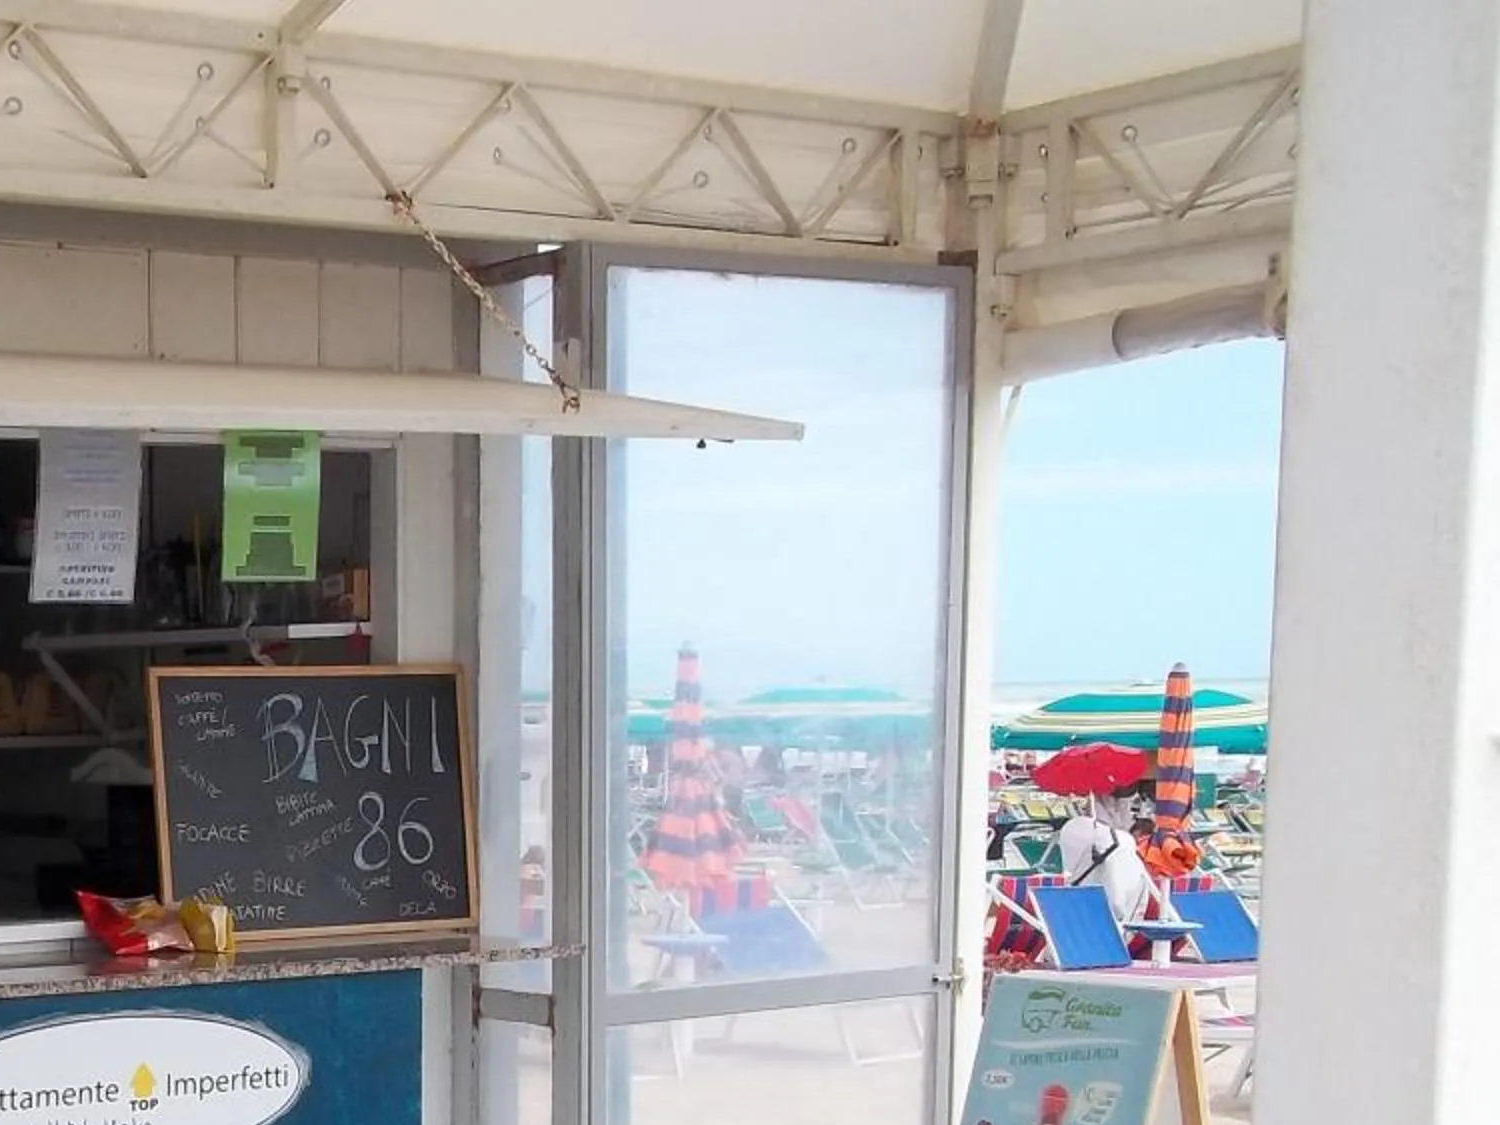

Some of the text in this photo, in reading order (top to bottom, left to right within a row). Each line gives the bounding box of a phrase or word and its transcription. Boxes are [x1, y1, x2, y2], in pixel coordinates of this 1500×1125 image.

[256, 692, 446, 784] BAGNI
[176, 823, 251, 843] FOCACCE
[353, 791, 434, 871] 86
[253, 869, 307, 897] BIRRE
[166, 1062, 290, 1103] Imperfetti
[129, 1099, 159, 1112] TOP
